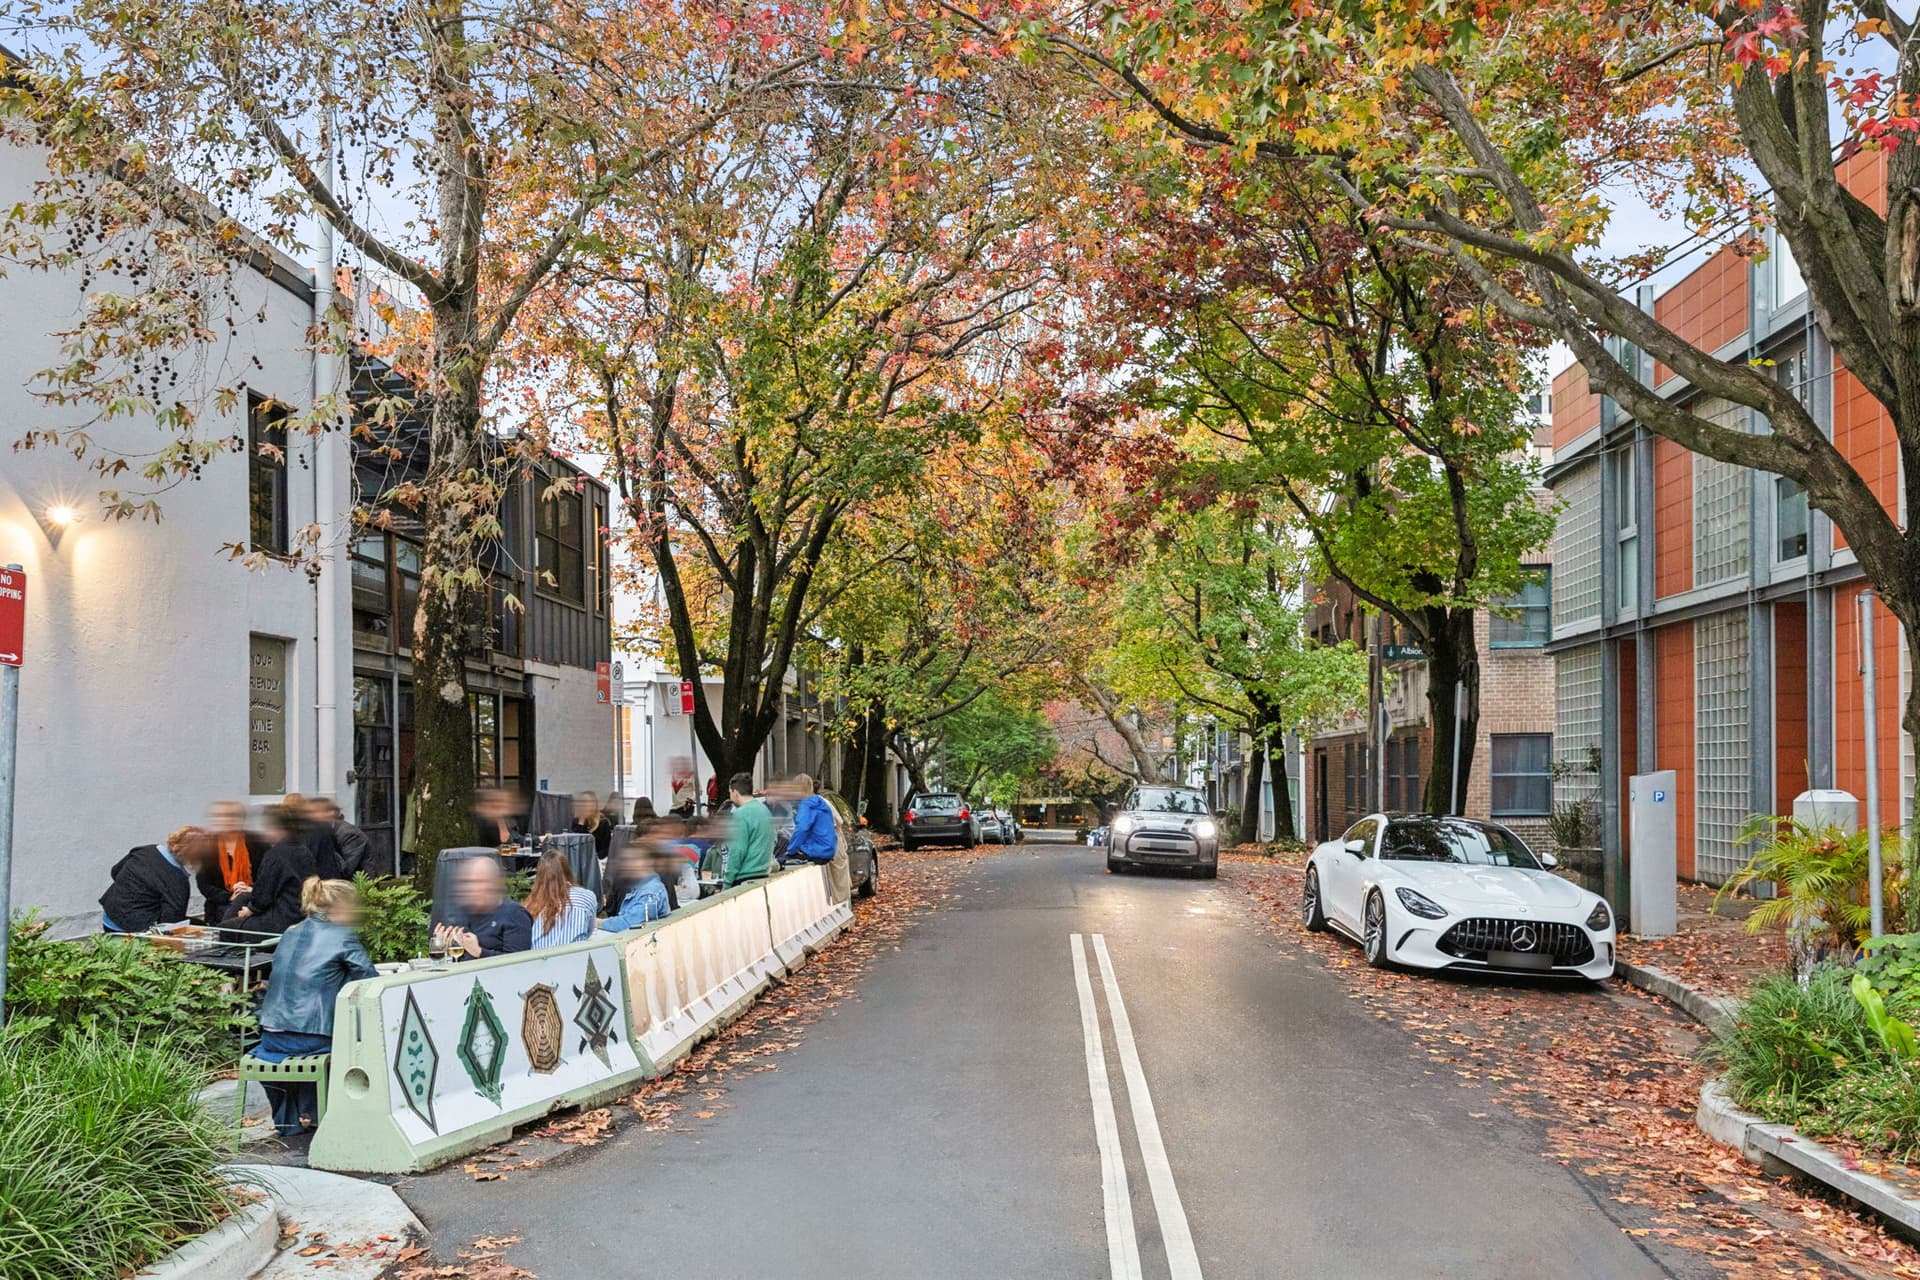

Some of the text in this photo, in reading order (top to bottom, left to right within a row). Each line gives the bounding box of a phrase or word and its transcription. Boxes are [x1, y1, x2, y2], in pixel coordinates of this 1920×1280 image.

[1, 574, 12, 585] NO
[0, 586, 22, 600] OPPING
[250, 676, 281, 692] RIENDLY
[251, 719, 273, 732] WINE
[252, 740, 270, 753] BAR
[1655, 791, 1664, 802] P
